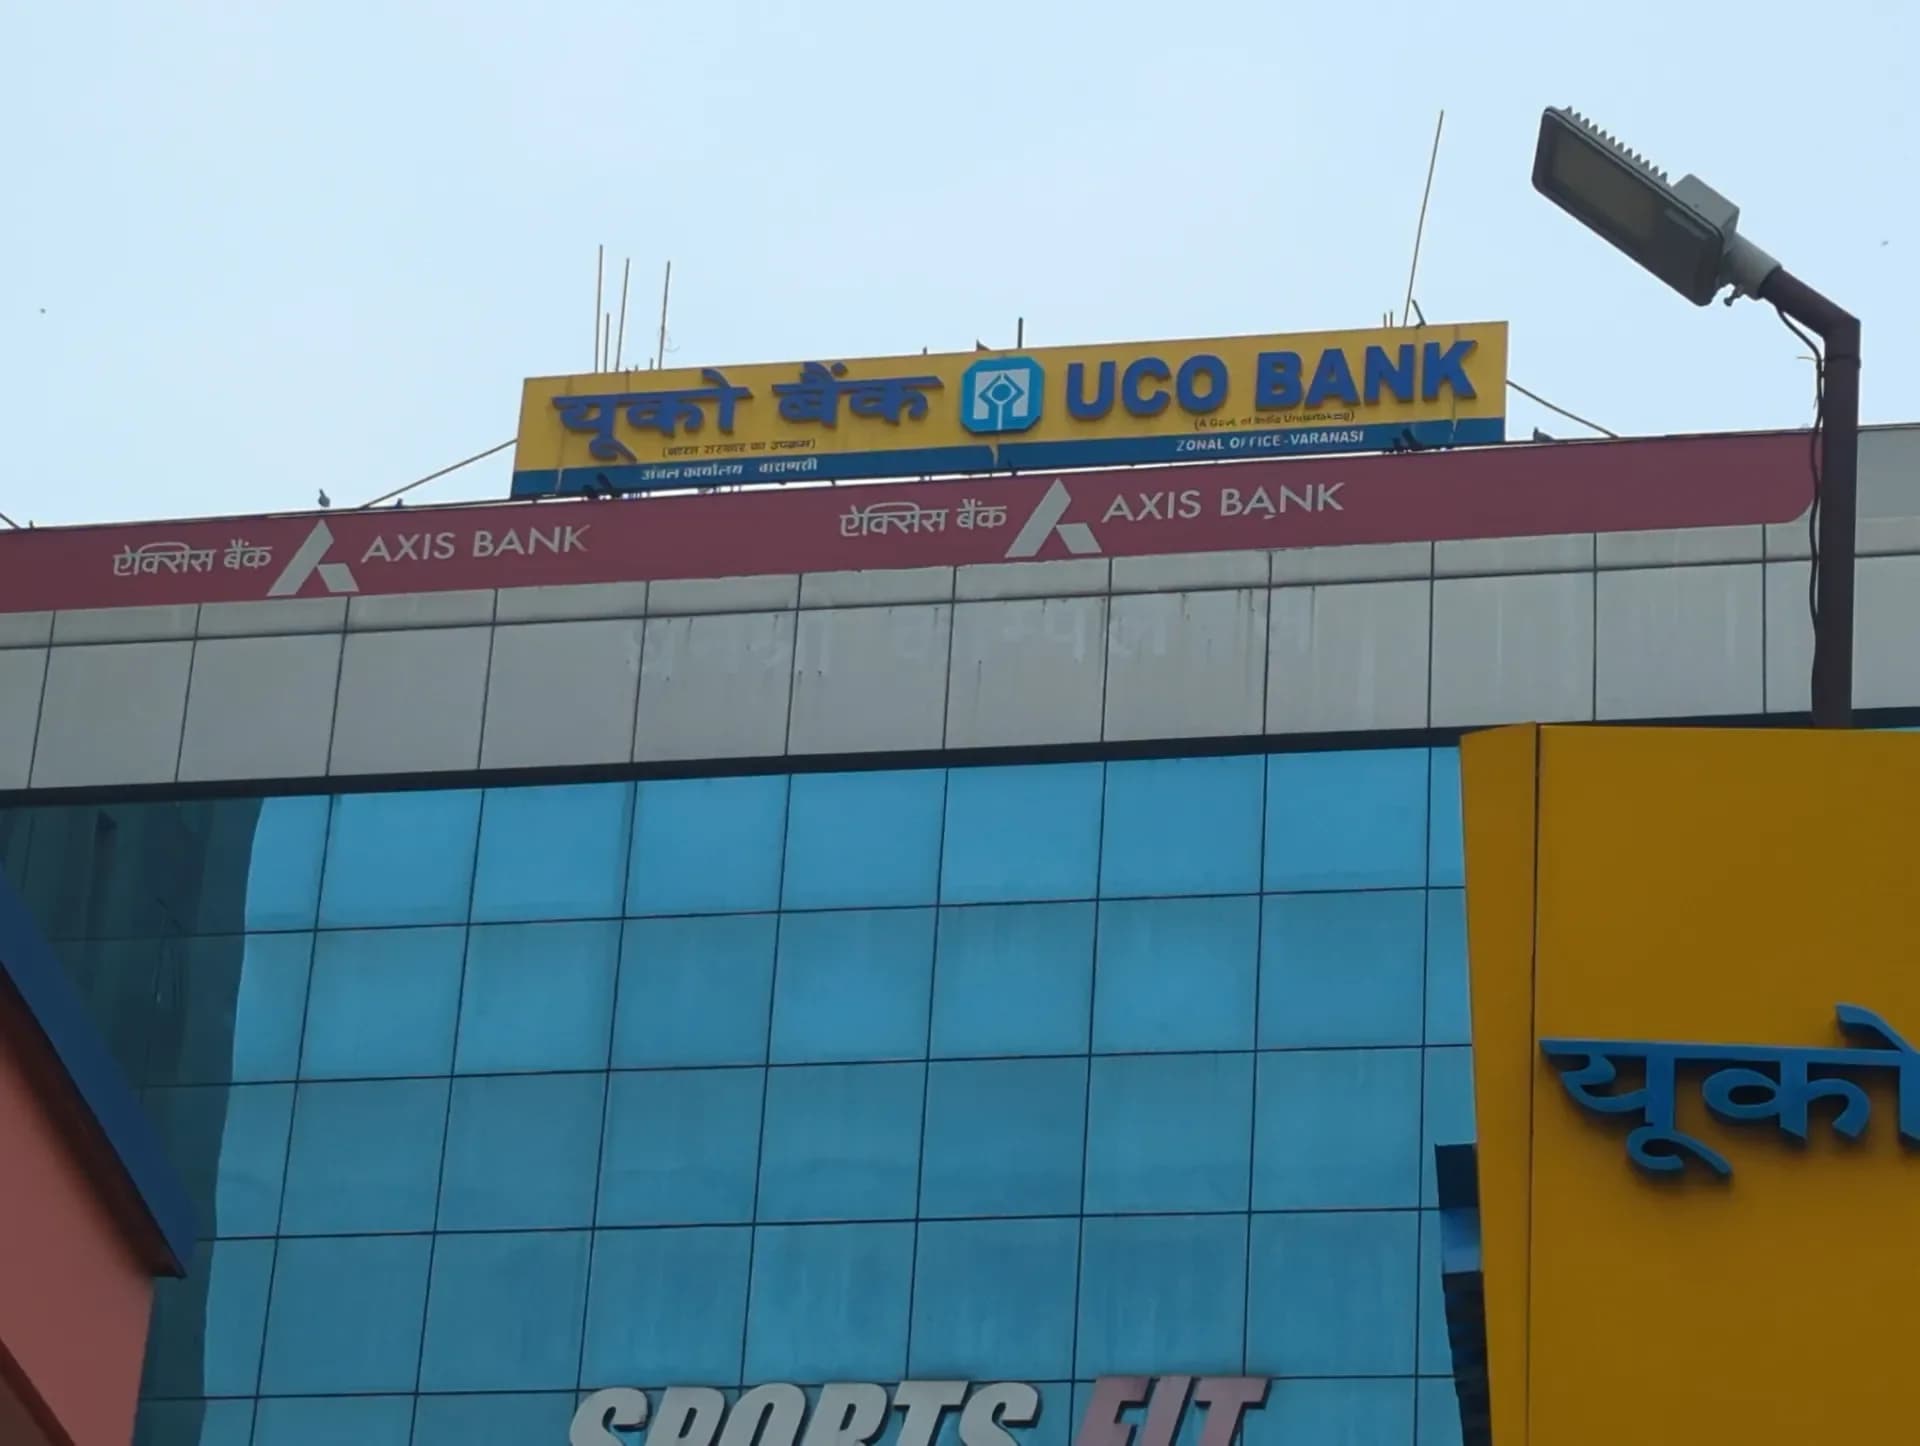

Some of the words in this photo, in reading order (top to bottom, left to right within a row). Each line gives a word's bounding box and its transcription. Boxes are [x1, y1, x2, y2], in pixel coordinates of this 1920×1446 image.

[1066, 354, 1229, 422] UCO
[1256, 339, 1481, 412] BANK
[551, 368, 755, 463] यूको
[771, 361, 944, 430] बैंक
[1176, 439, 1224, 452] ZONAL
[956, 498, 1007, 530] बैंक
[1102, 489, 1201, 523] AXIS
[1220, 482, 1344, 520] BANK
[223, 538, 273, 570] बैंक
[361, 532, 455, 564] AXIS
[473, 525, 592, 558] BANK
[569, 1381, 1040, 1446] SPORTS
